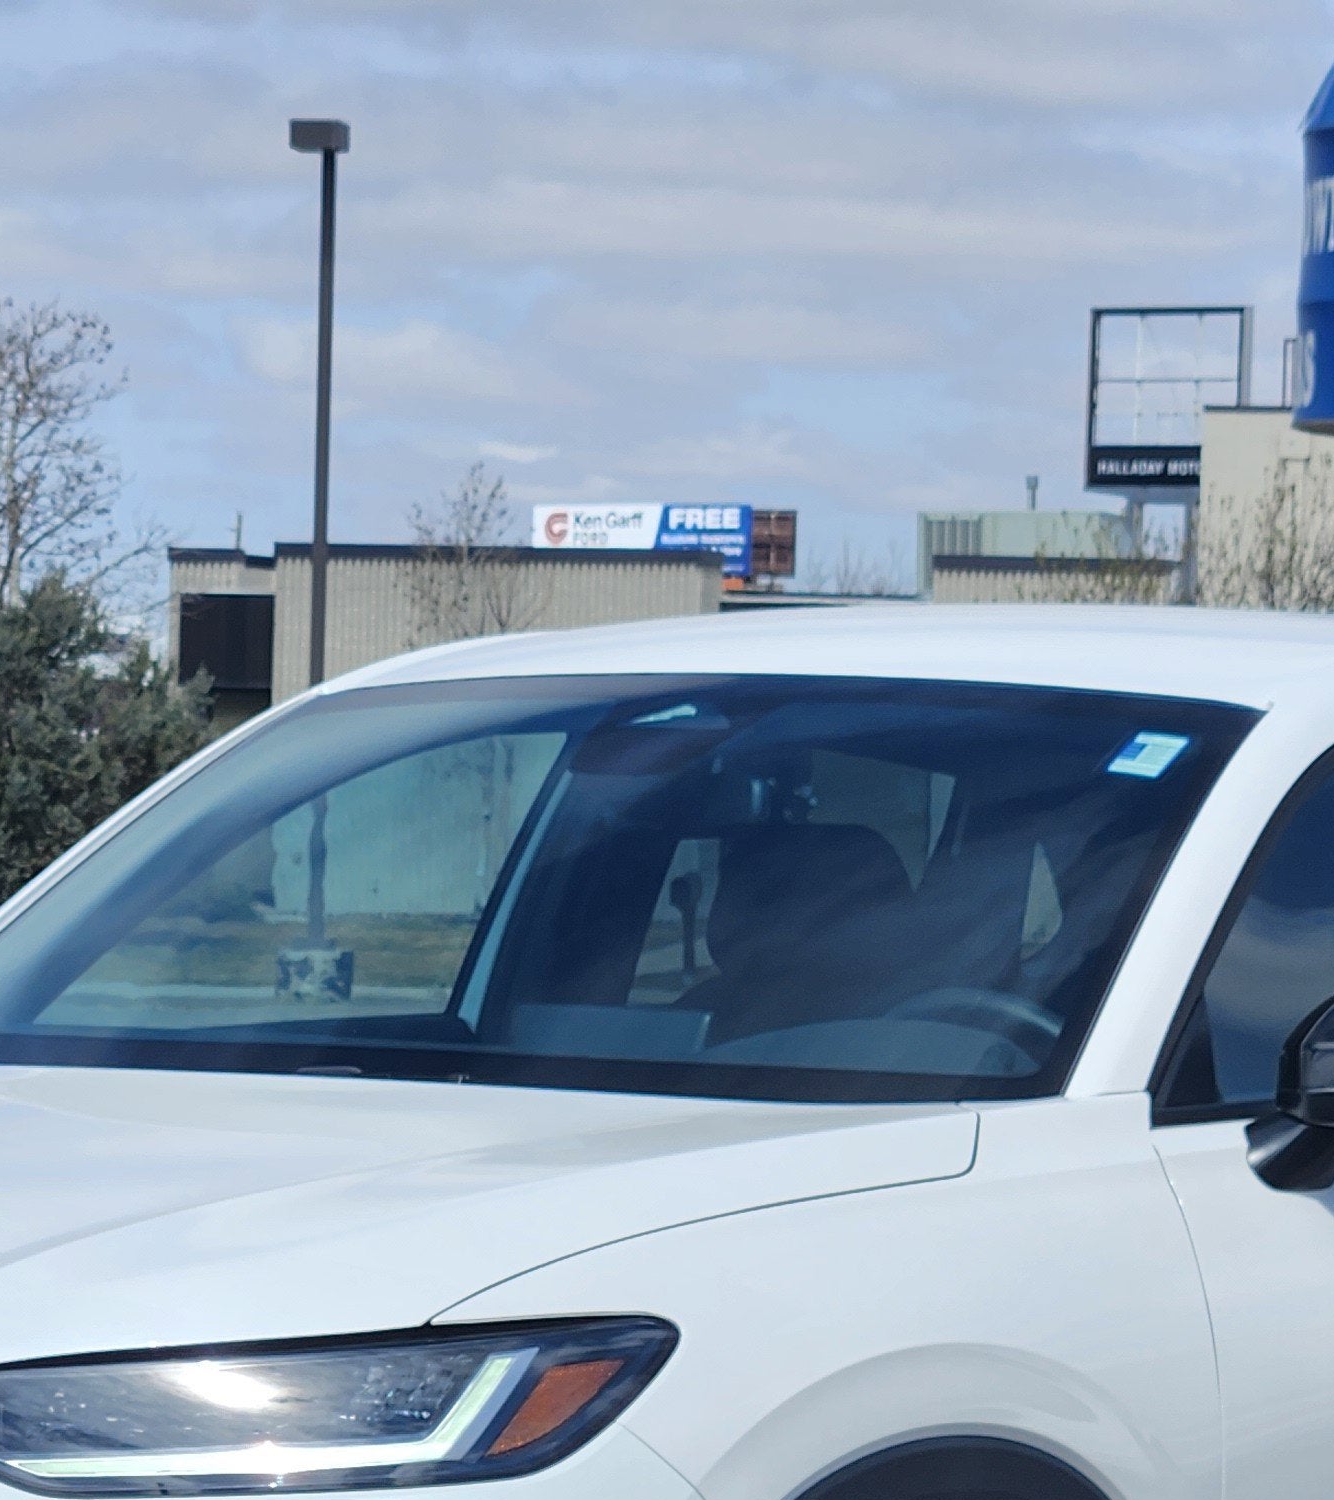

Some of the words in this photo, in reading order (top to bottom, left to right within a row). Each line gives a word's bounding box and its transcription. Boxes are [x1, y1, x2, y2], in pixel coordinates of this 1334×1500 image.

[573, 513, 602, 529] Ken
[605, 512, 643, 530] Garff
[668, 508, 741, 530] FREE
